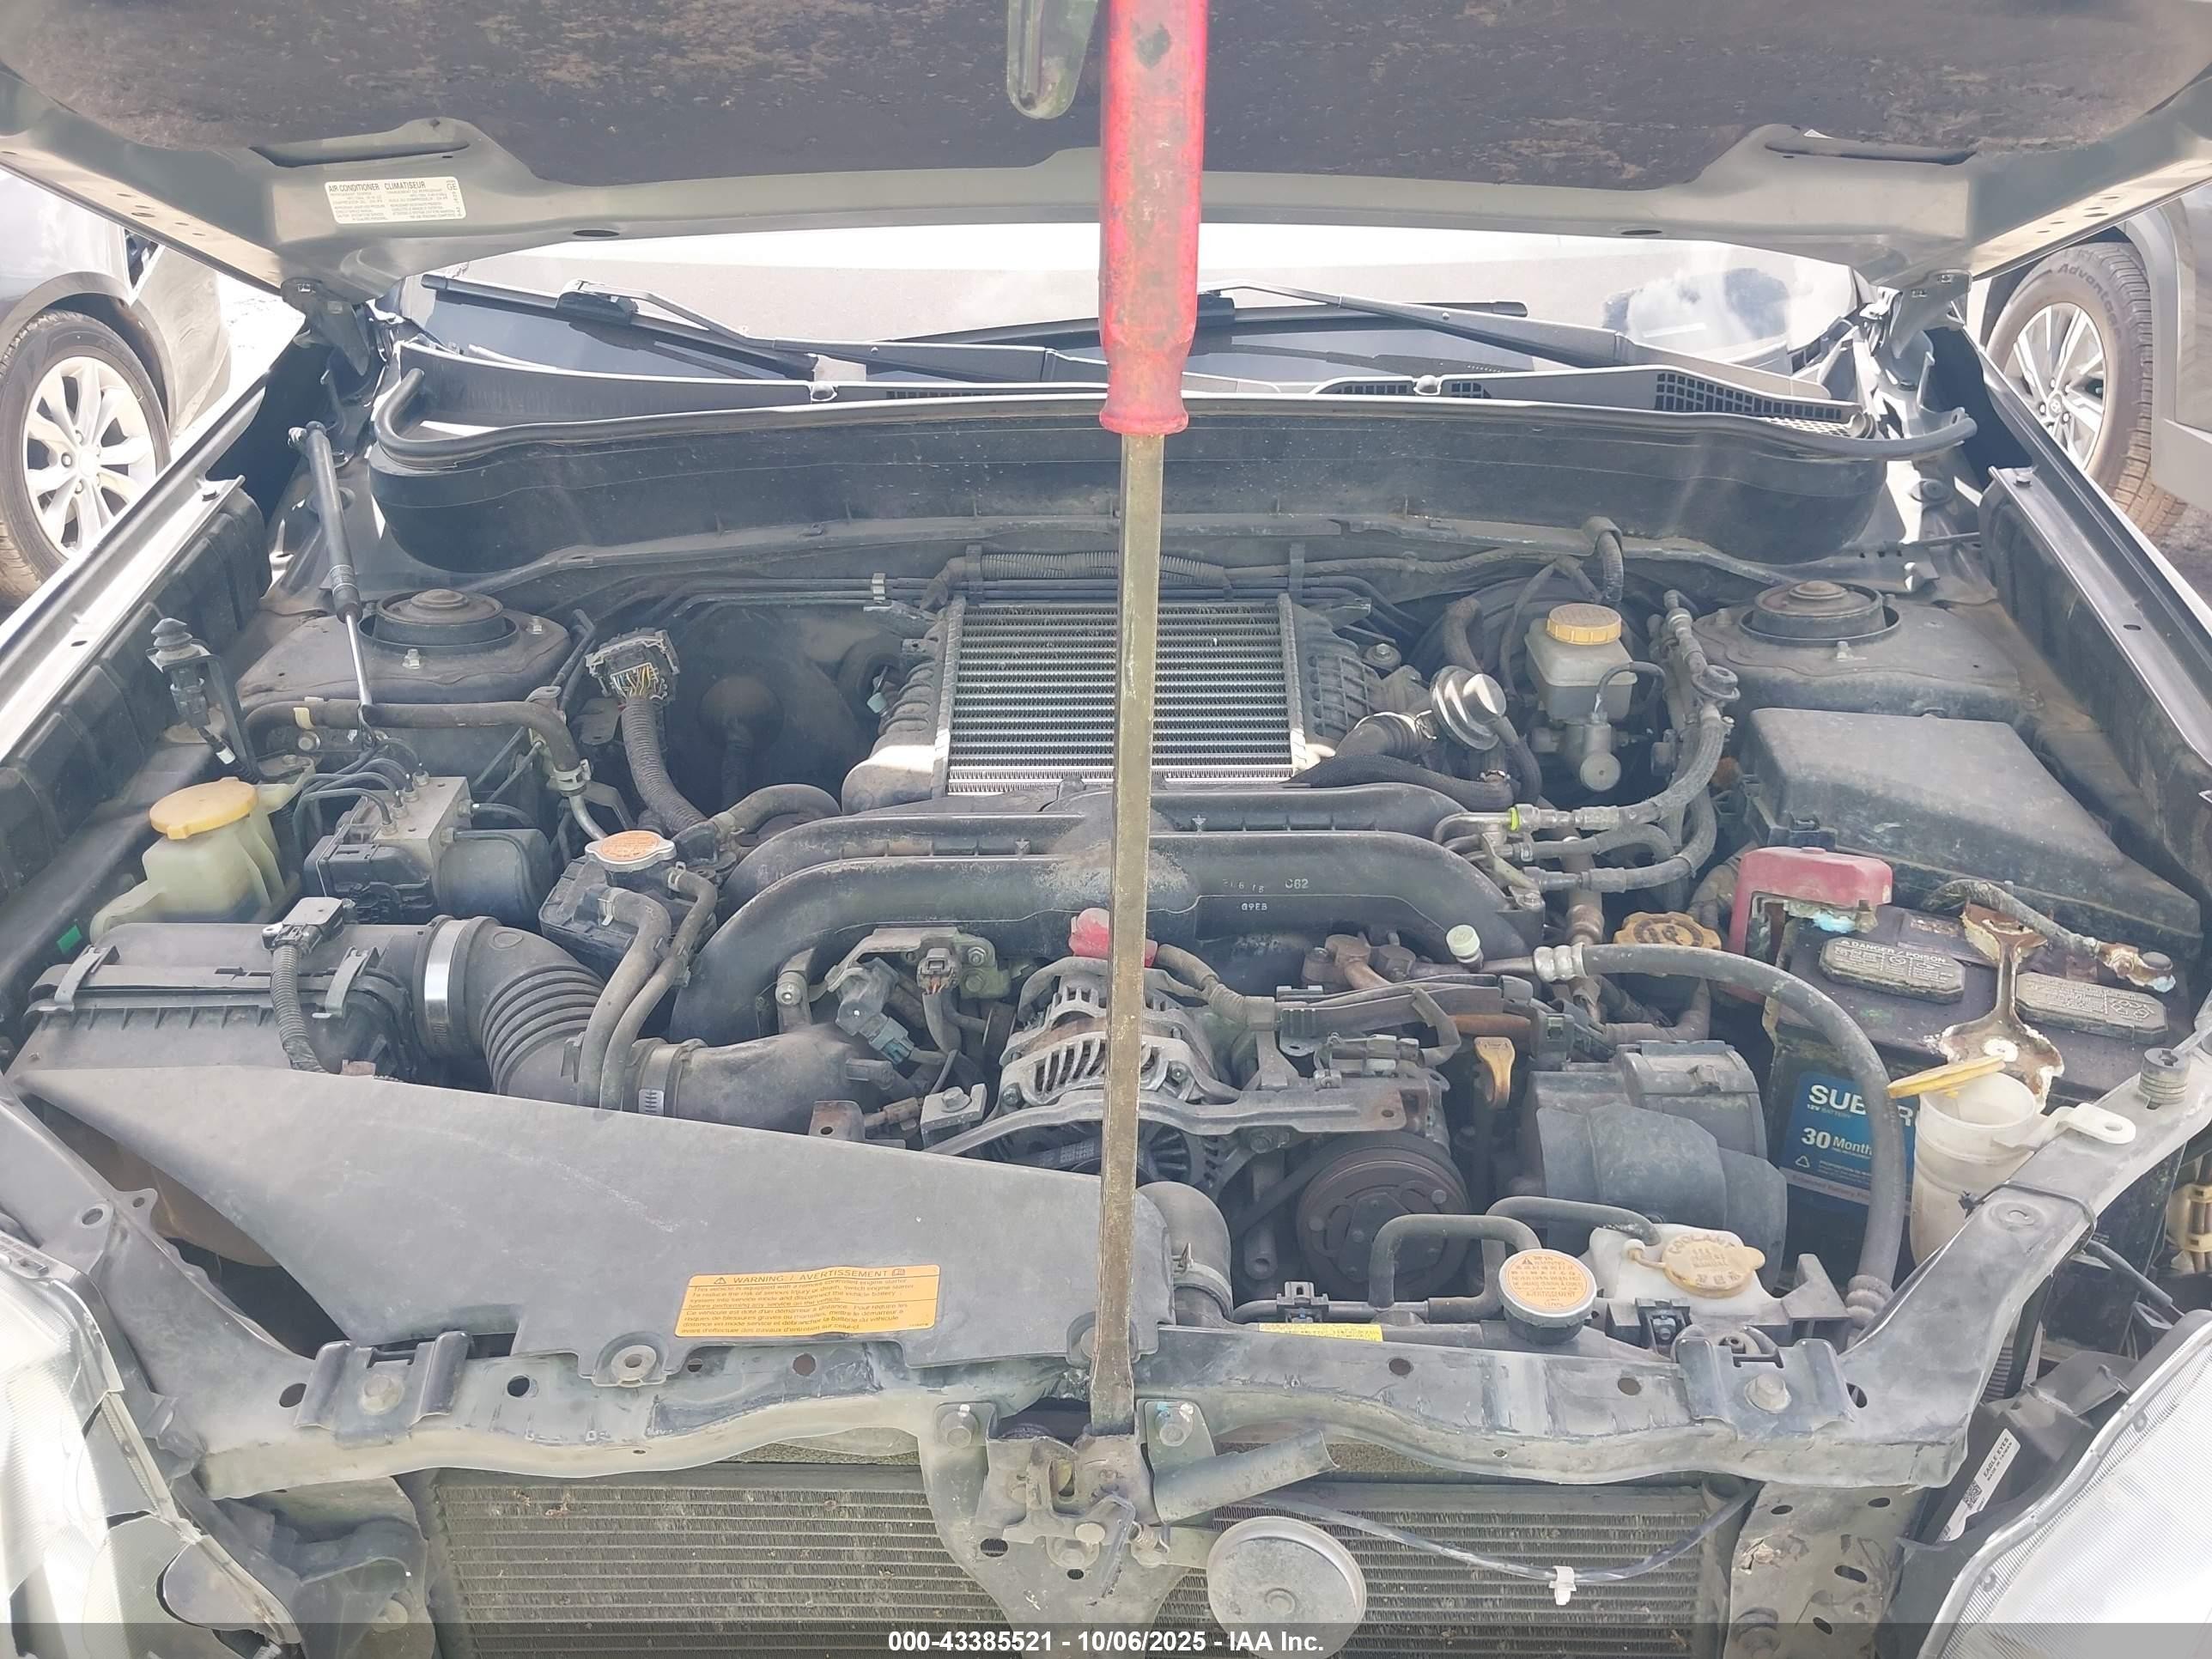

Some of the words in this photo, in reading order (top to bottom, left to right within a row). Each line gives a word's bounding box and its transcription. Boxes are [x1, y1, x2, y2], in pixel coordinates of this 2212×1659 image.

[339, 183, 380, 191] CONDITIONER
[384, 181, 426, 190] CLIMATISEUR
[1851, 941, 1895, 954] DANGER
[1905, 951, 1947, 963] POISON
[1801, 1127, 1831, 1150] 30
[1668, 1233, 1736, 1255] COOLANT
[799, 1270, 887, 1281] AVERTISSEMENT
[1983, 1454, 1998, 1478] EAGLE
[1996, 1437, 2009, 1456] EYES
[1987, 1466, 1997, 1481] MADE
[1999, 1442, 2013, 1462] TAIWAN
